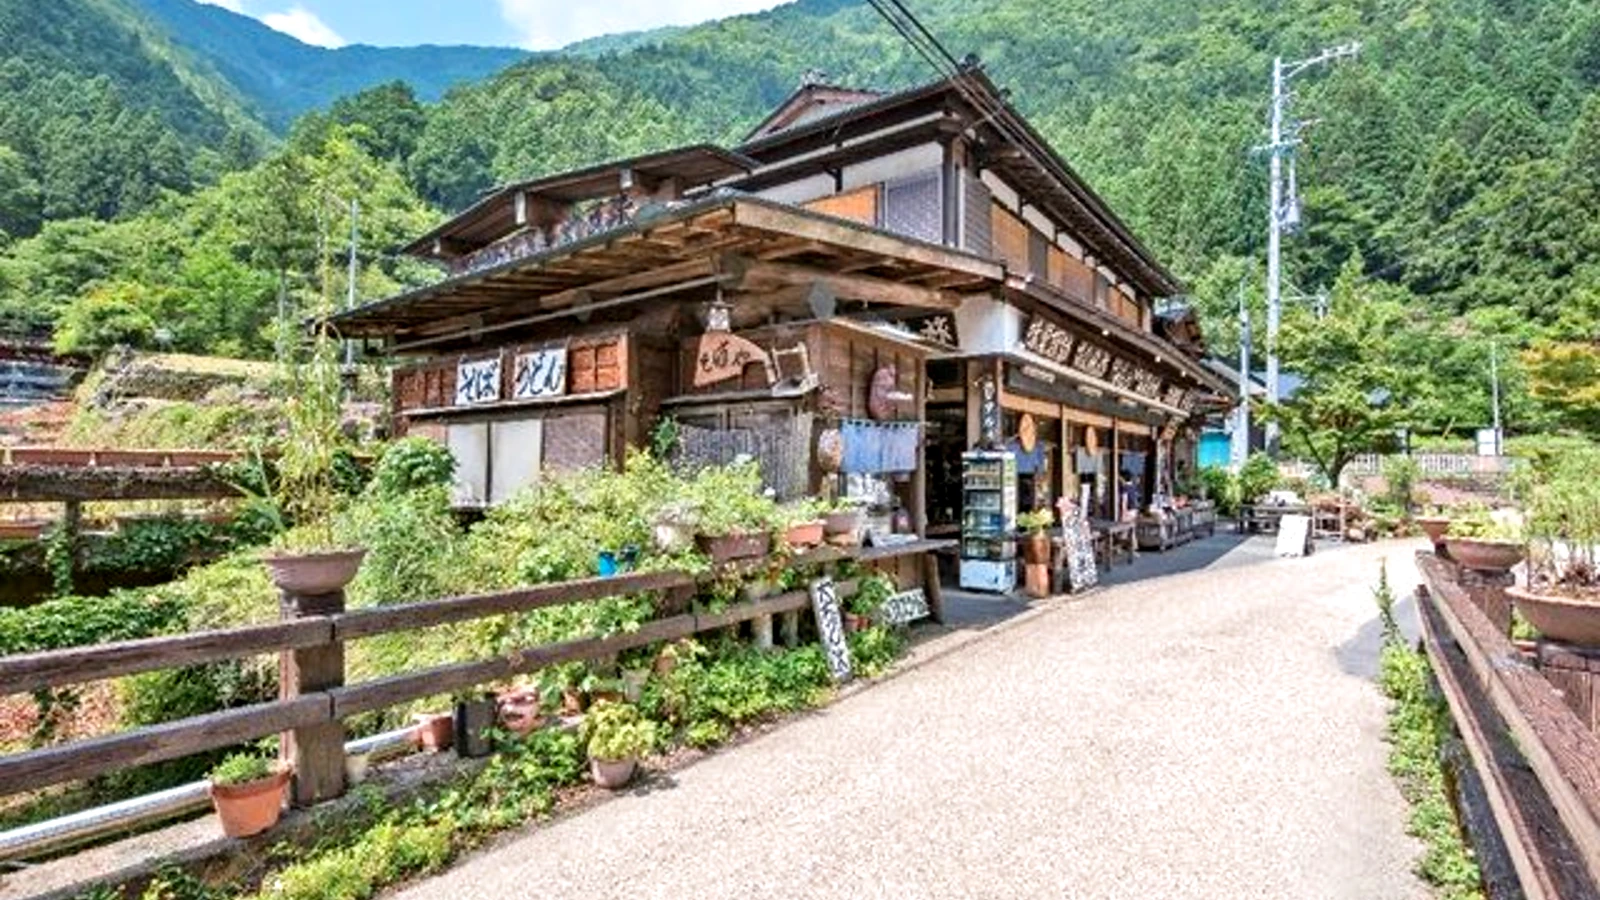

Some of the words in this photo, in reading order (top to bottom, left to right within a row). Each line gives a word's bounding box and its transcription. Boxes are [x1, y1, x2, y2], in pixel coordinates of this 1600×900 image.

[460, 361, 498, 401] そば
[515, 350, 563, 395] うどん
